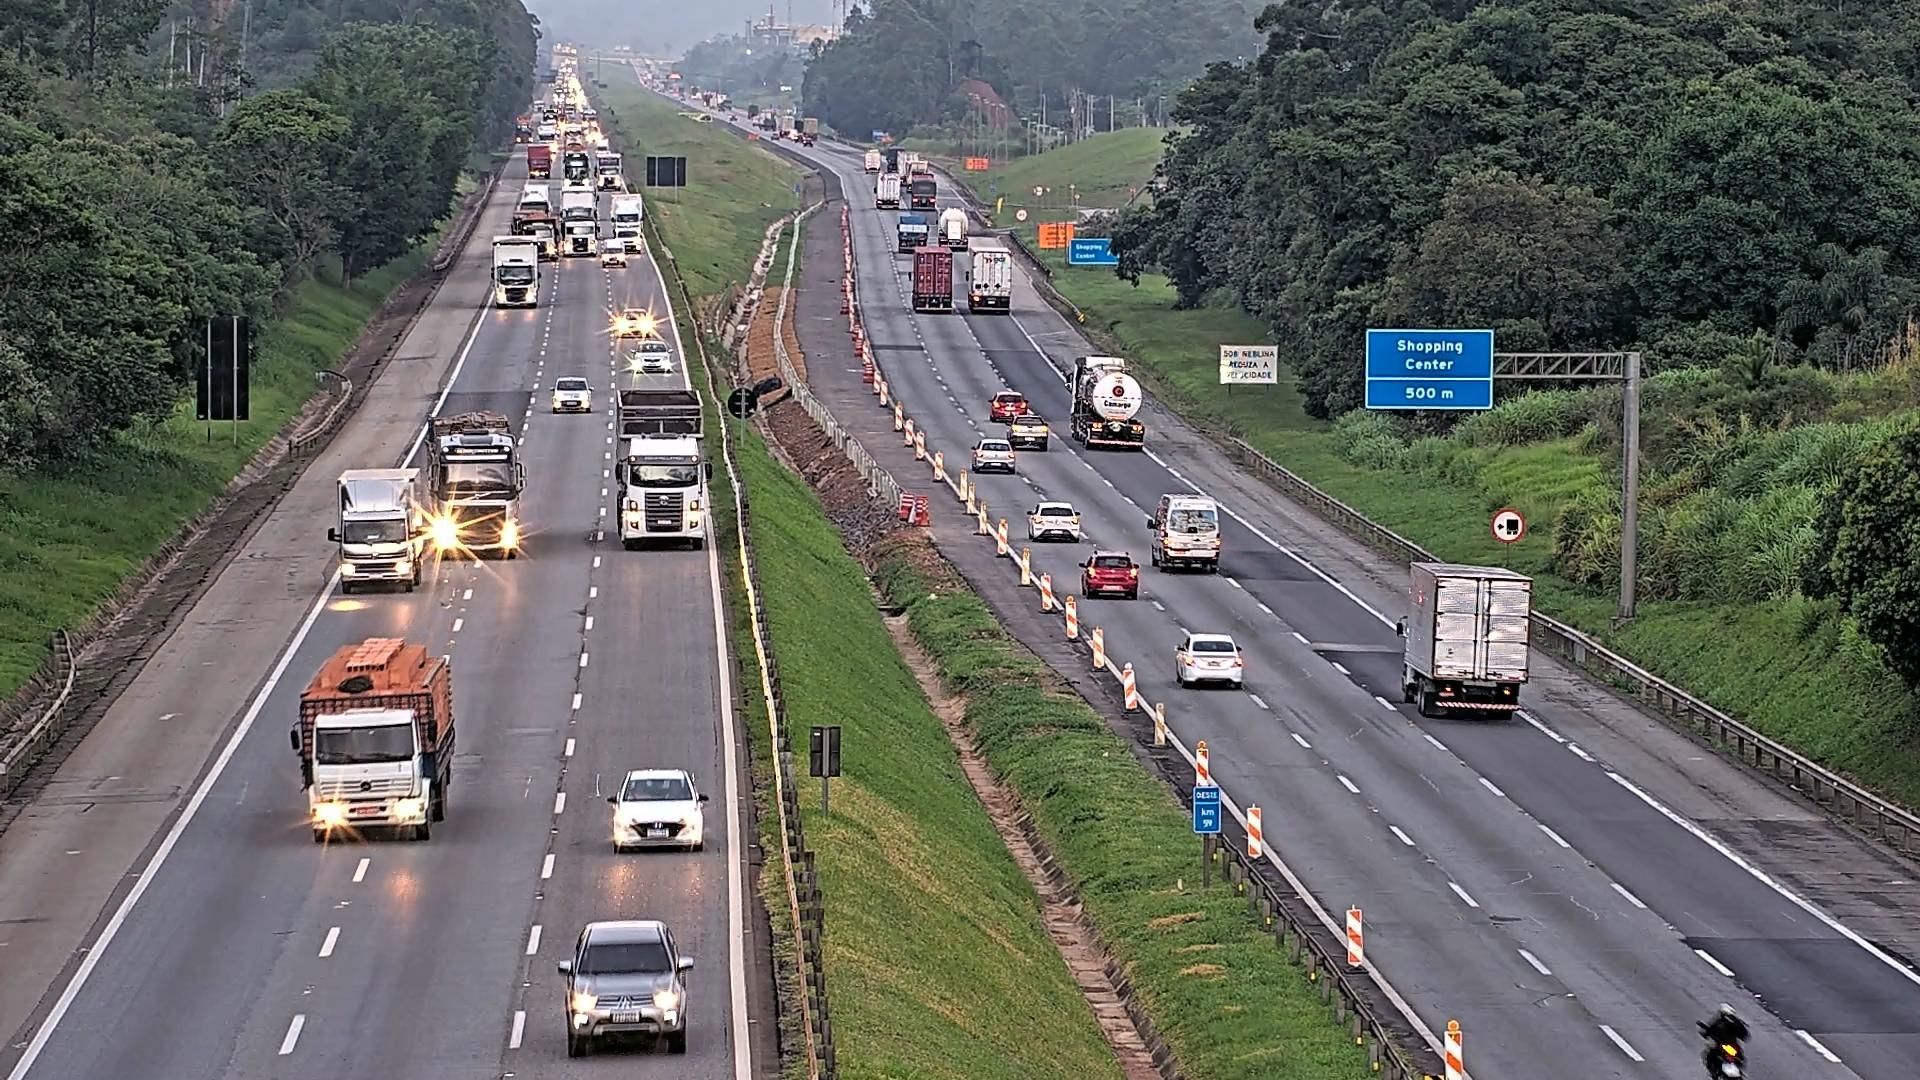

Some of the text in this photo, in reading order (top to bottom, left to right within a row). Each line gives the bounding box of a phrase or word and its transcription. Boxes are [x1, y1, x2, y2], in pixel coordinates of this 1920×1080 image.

[1397, 339, 1463, 354] Shopping
[1223, 350, 1275, 358] SOB NEBLINA
[1263, 361, 1269, 369] A
[1405, 358, 1454, 370] Center
[1405, 387, 1454, 399] 500 m
[1201, 807, 1215, 816] km
